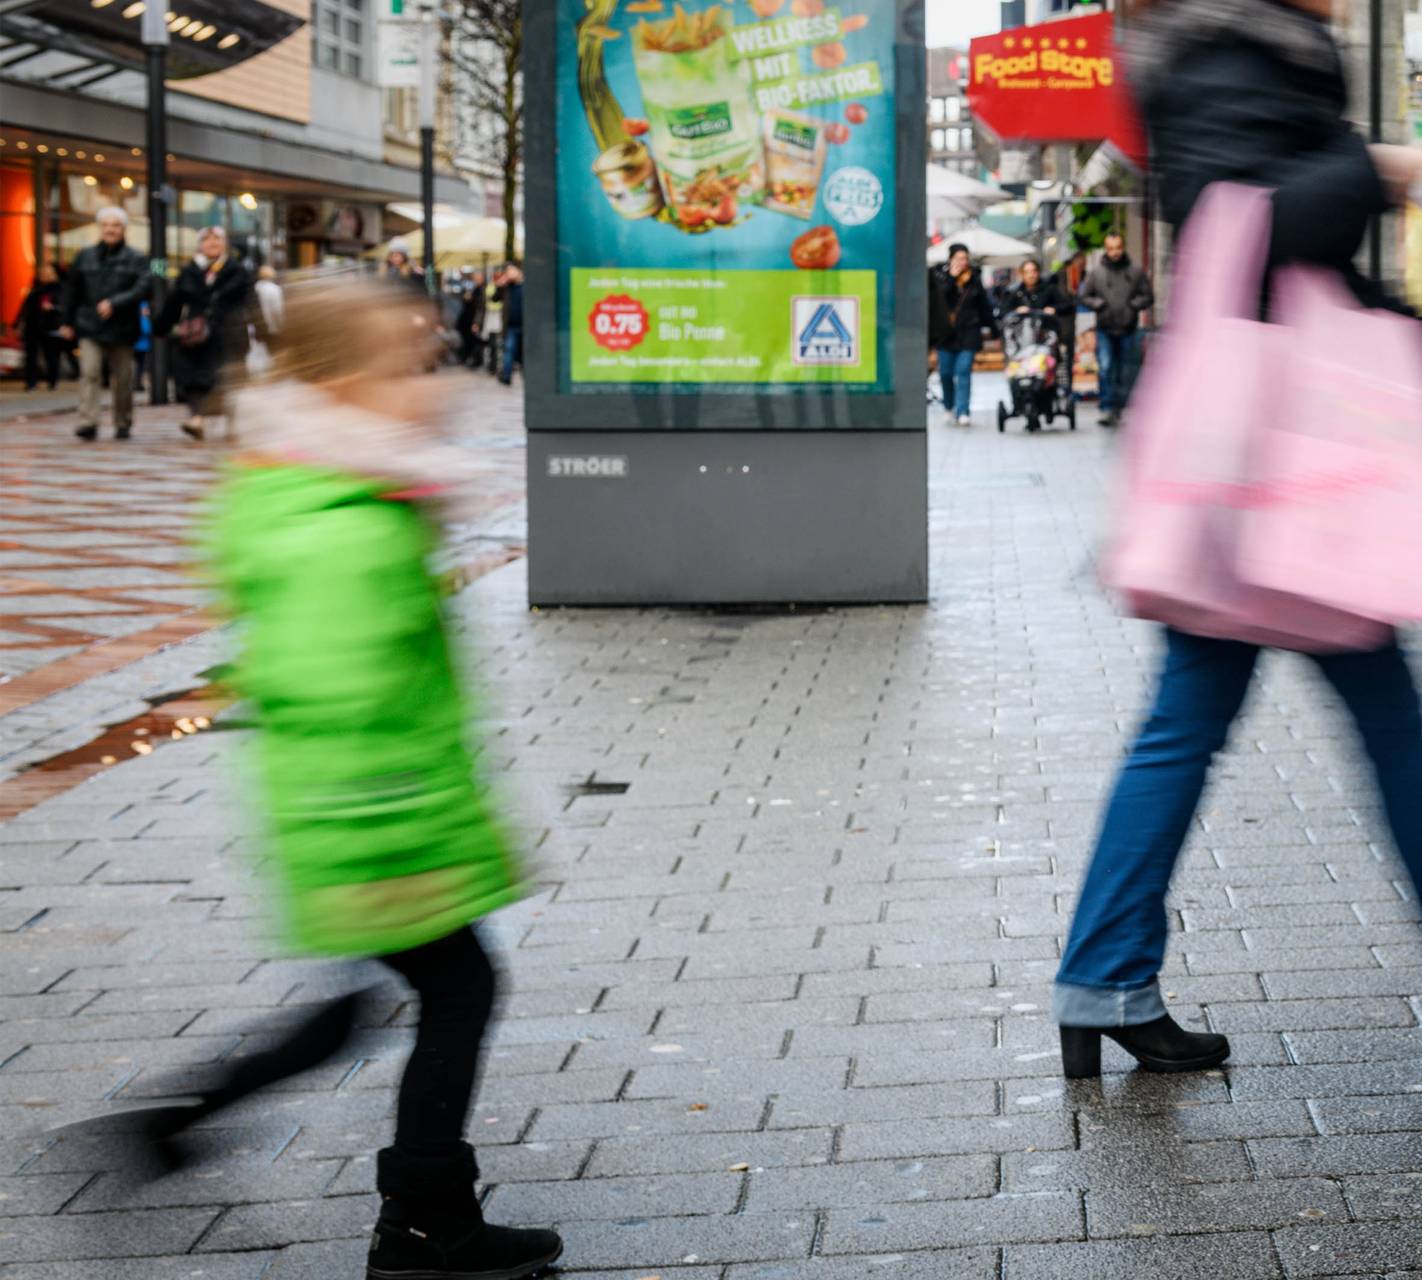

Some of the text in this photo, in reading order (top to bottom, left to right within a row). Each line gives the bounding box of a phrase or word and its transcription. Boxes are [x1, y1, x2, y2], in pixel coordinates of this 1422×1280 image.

[732, 14, 837, 53] WELLNESS
[755, 53, 789, 80] MIT
[975, 50, 1113, 86] Food Store
[595, 313, 642, 335] 0.75
[549, 456, 625, 475] STRÖER
